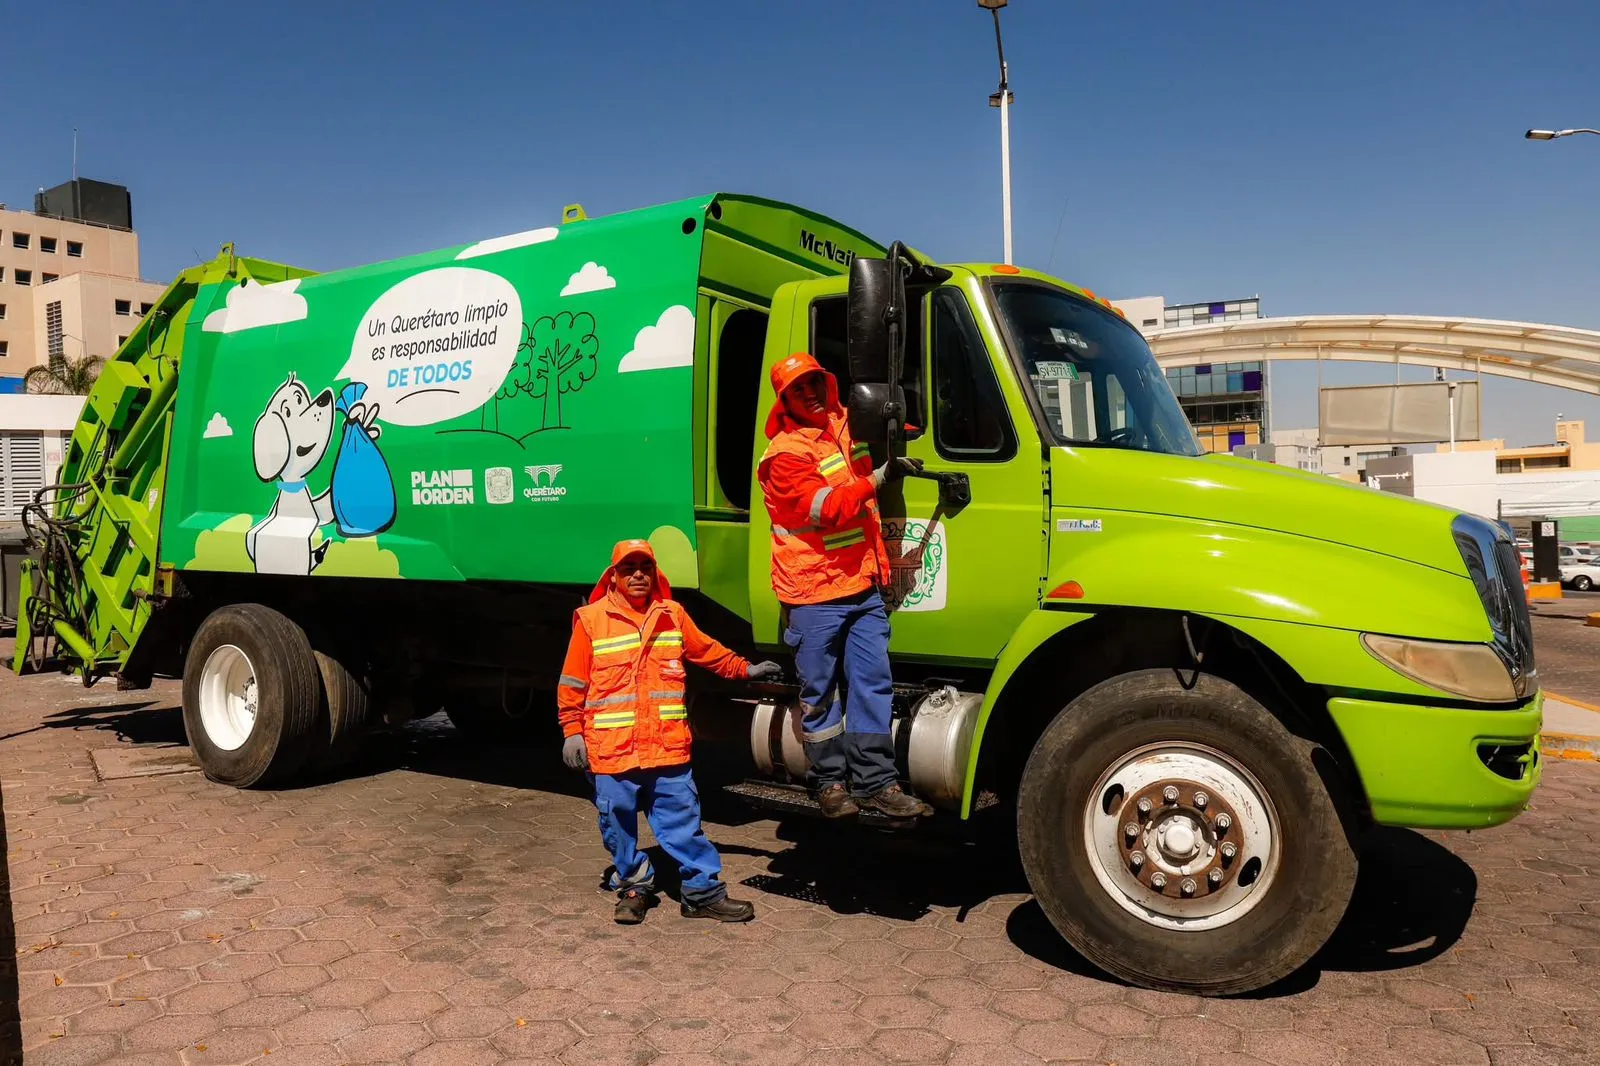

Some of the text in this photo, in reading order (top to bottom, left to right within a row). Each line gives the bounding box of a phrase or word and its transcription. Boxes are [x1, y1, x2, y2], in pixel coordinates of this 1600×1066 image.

[368, 299, 508, 338] Un Querétaro limpio
[371, 325, 498, 361] es responsabilidad
[387, 360, 473, 388] DE TODOS
[411, 470, 453, 488] PLAN
[420, 488, 474, 505] ORDEN
[523, 486, 567, 498] QUERÉTARO
